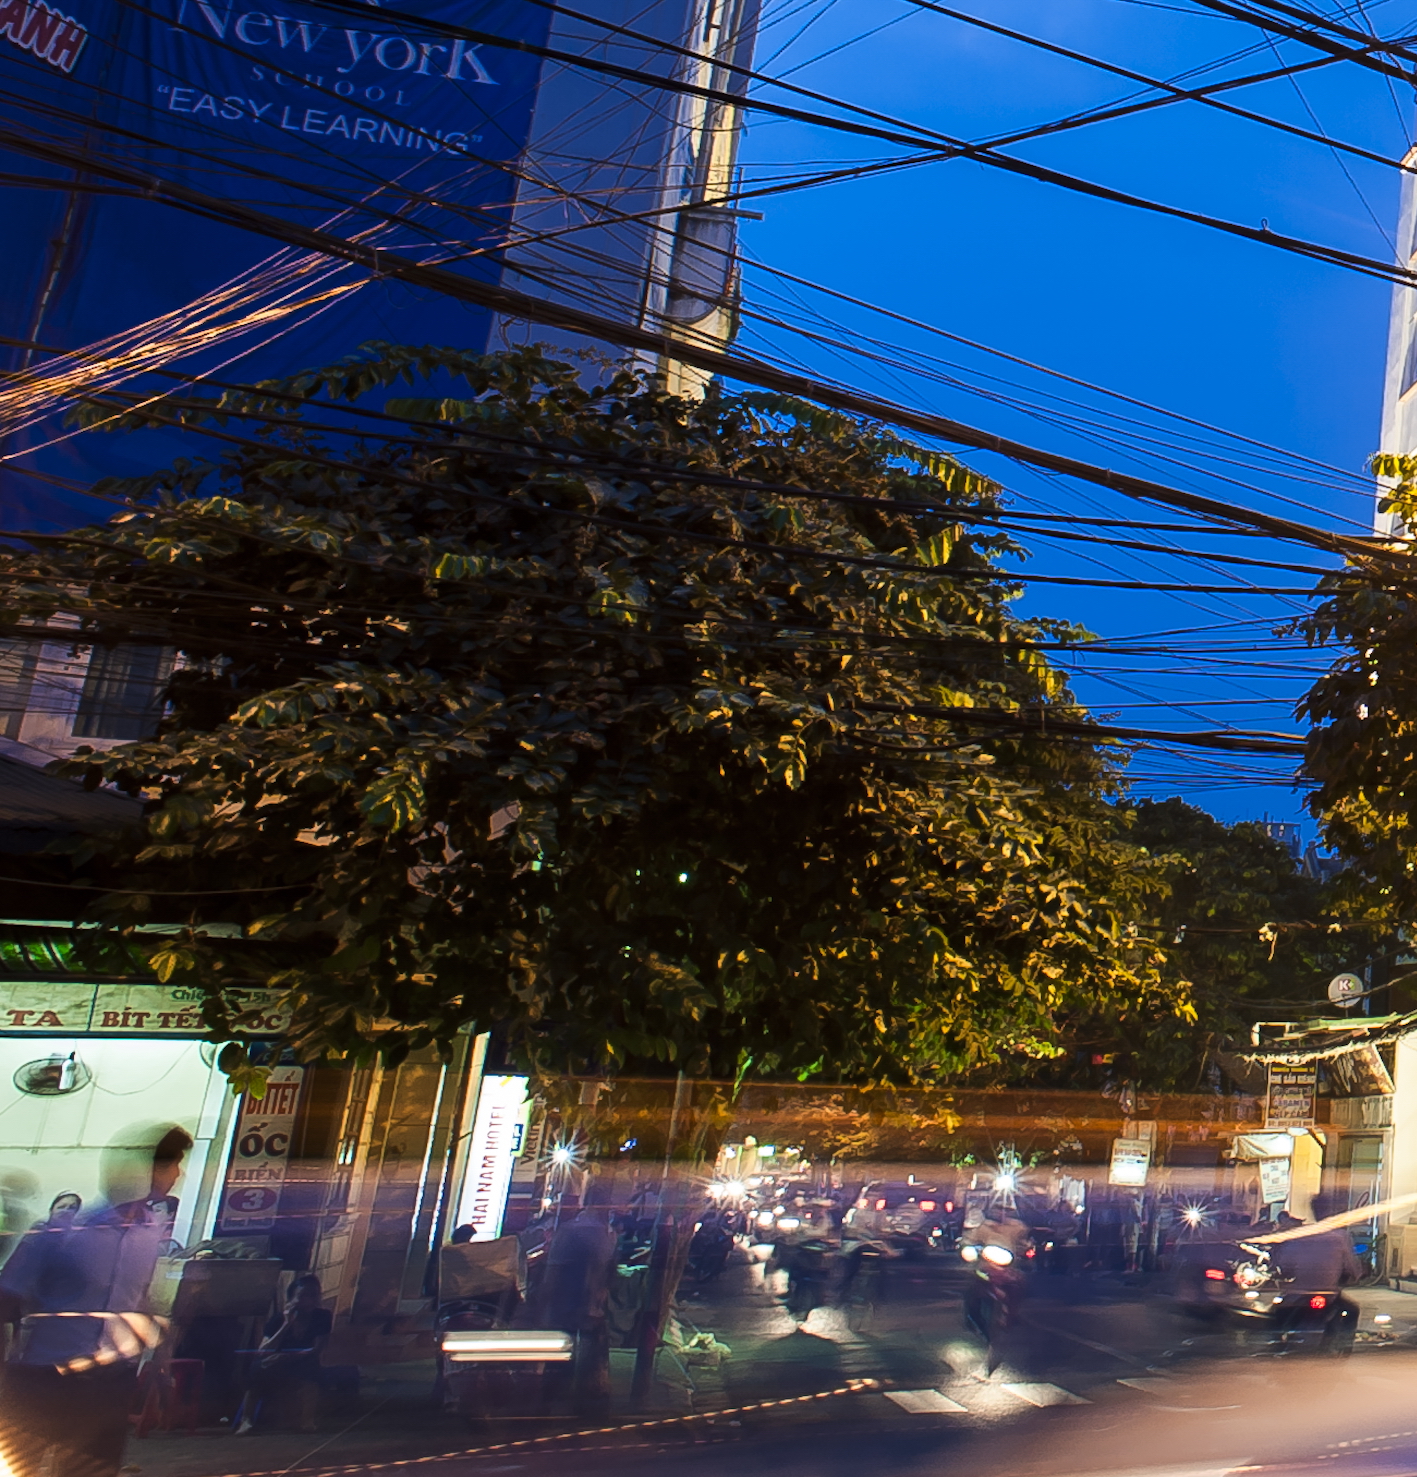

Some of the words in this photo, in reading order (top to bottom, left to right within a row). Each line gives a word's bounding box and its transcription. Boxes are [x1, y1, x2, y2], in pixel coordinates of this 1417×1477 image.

[251, 65, 412, 107] SCHOOL
[102, 1006, 150, 1029] BÍT
[239, 1122, 290, 1158] ỐC
[476, 1155, 497, 1194] NAM
[242, 1188, 264, 1211] 3
